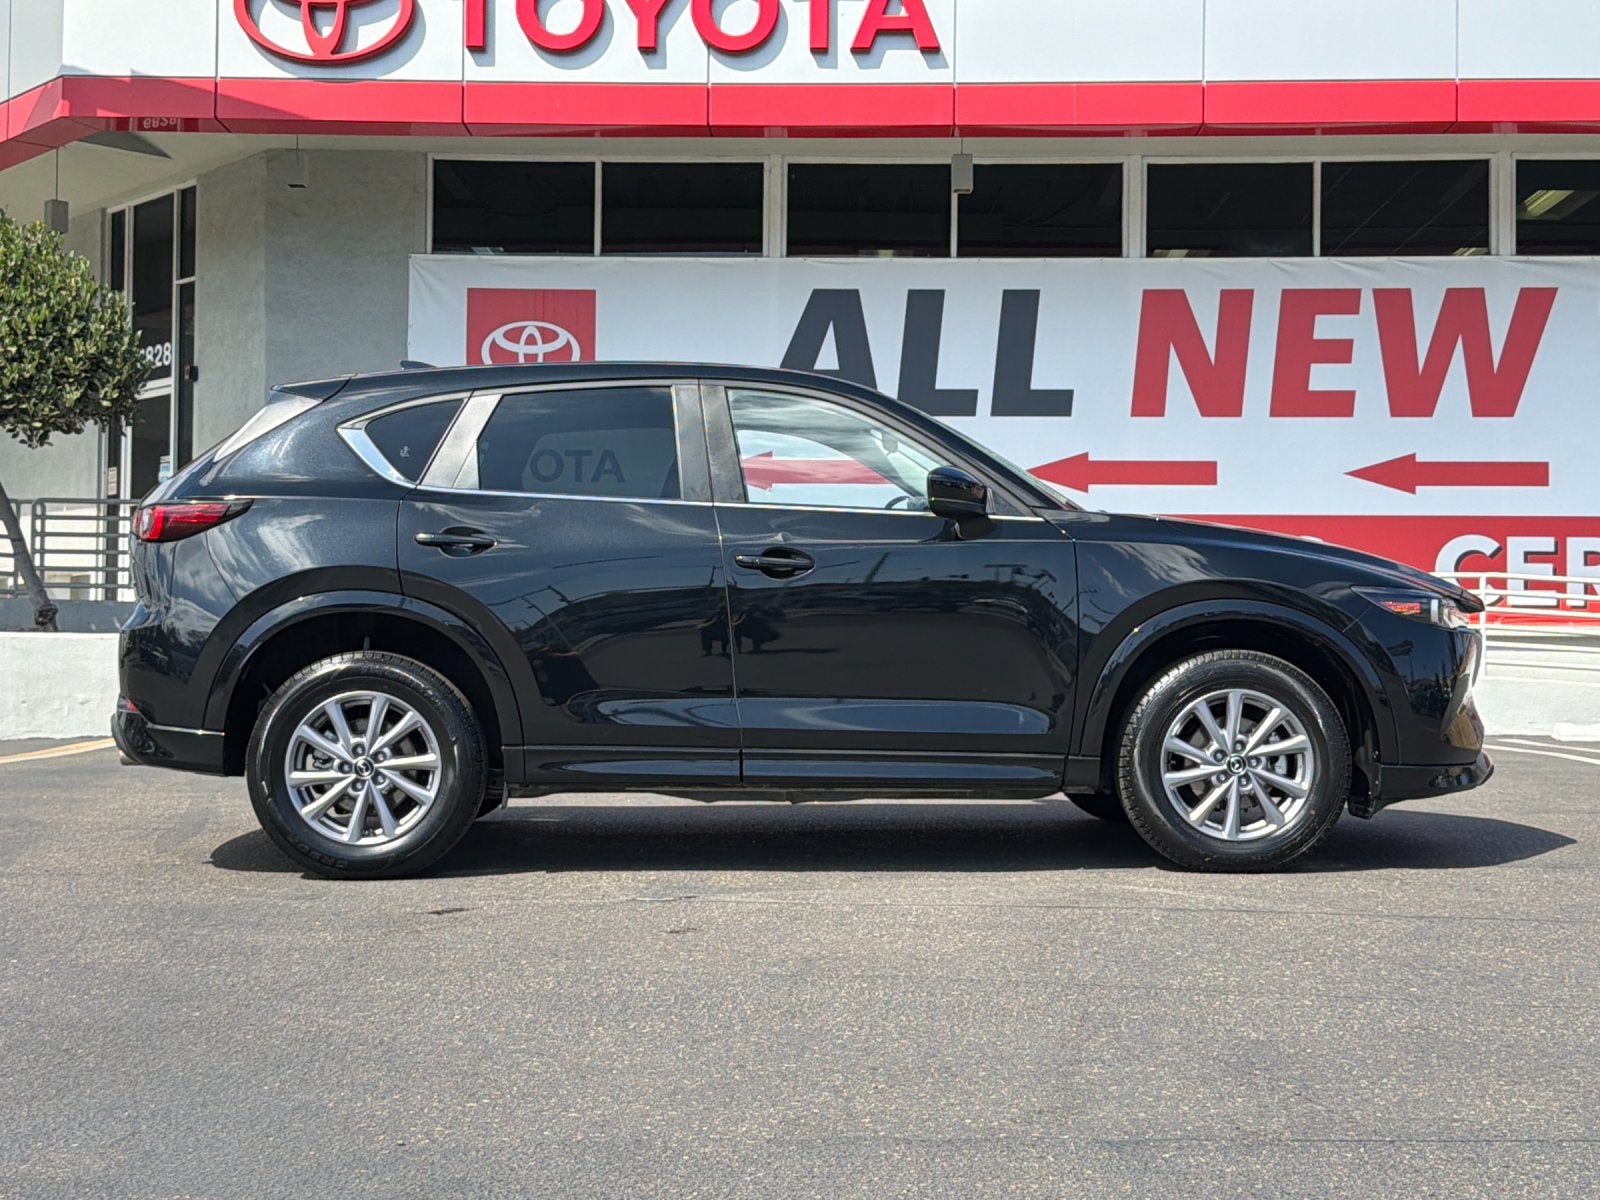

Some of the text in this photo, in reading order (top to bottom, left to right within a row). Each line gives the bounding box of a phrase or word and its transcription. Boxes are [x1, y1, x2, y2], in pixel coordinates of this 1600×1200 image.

[140, 342, 172, 369] 828
[780, 287, 1559, 418] ALL NEW
